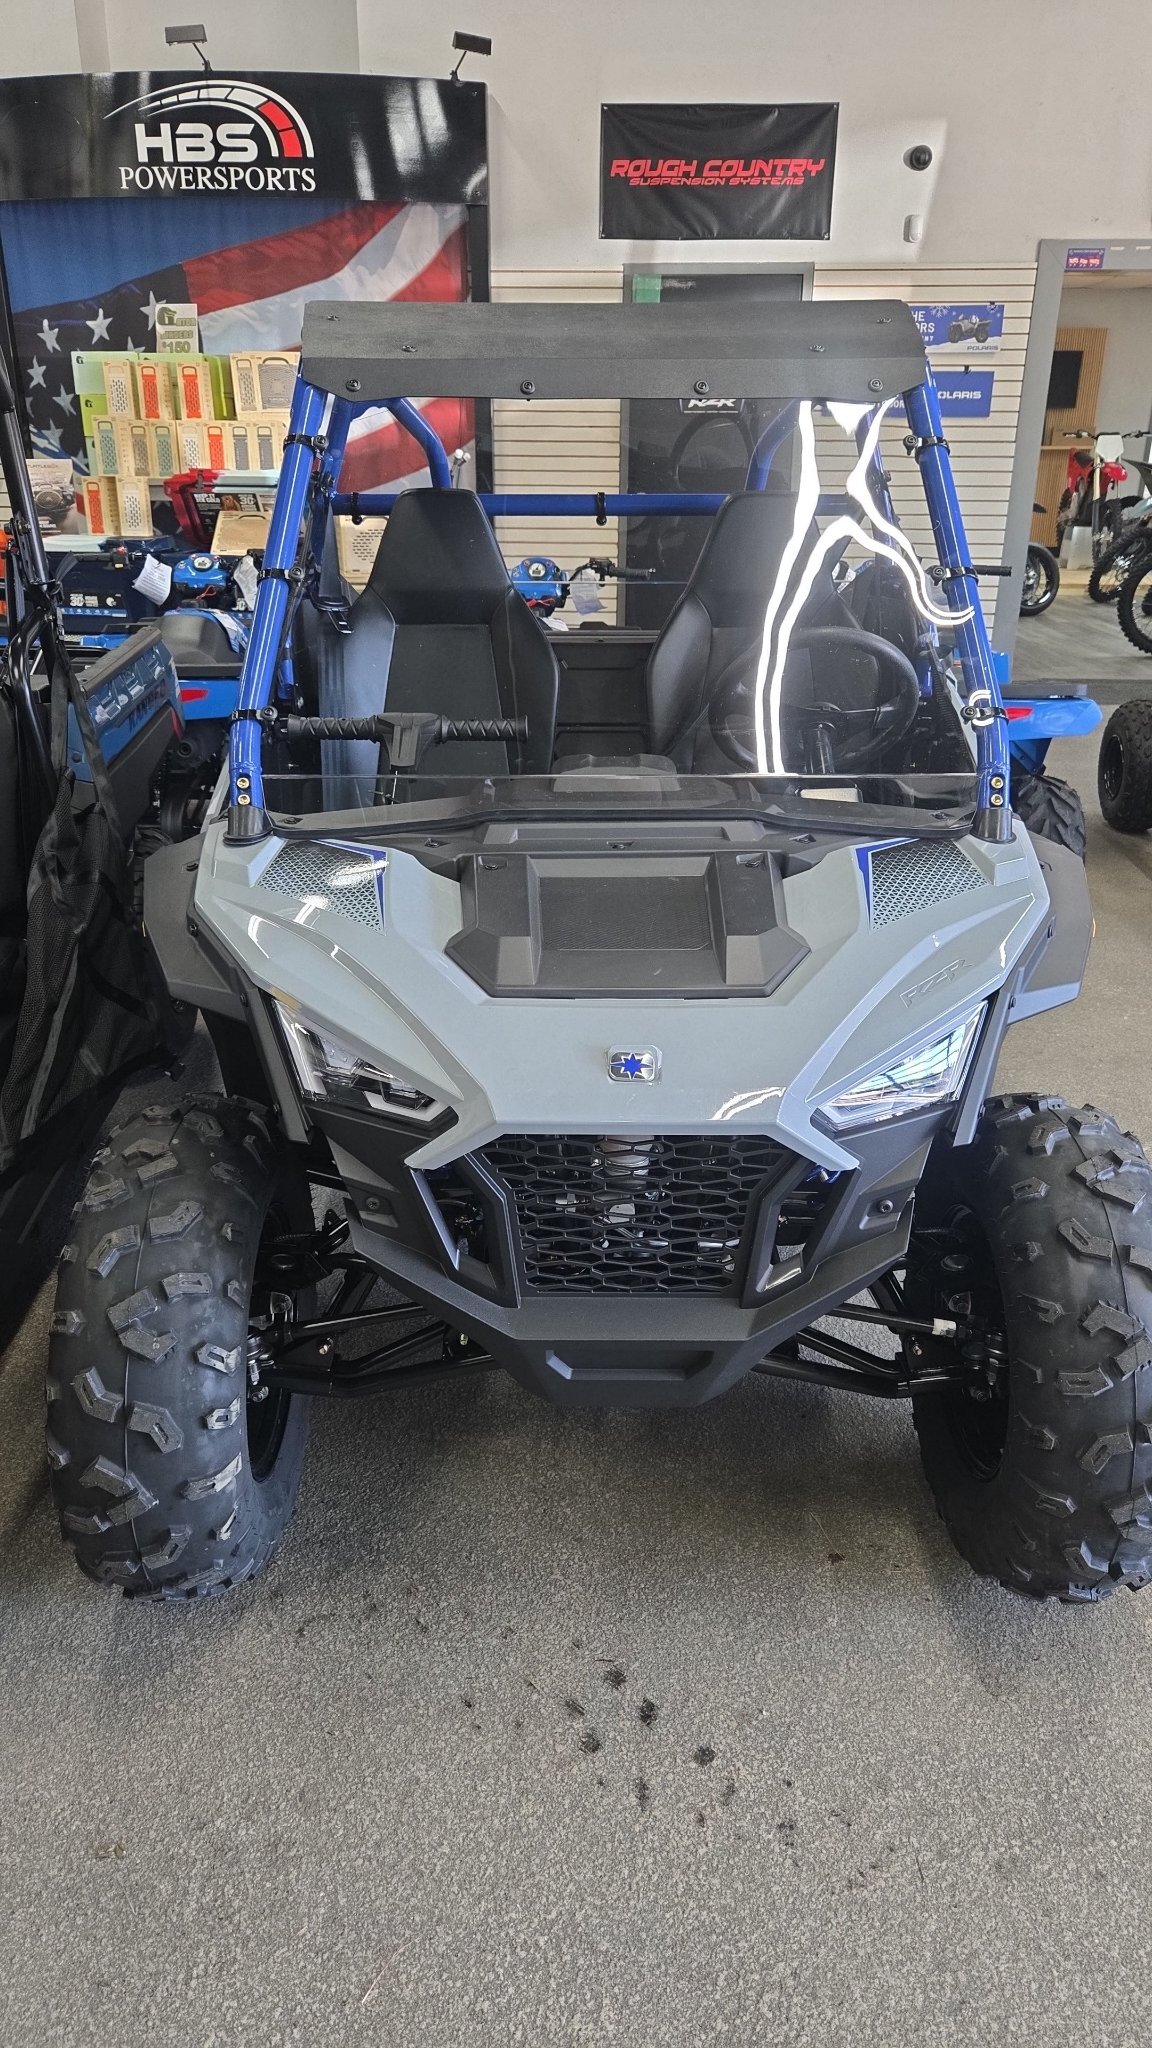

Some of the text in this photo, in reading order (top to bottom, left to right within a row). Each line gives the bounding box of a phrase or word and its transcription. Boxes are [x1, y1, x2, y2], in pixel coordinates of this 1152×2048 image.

[134, 122, 259, 163] HBS
[610, 158, 826, 177] ROUGH COUNTRY
[118, 166, 317, 192] POWERSPORTS
[629, 177, 805, 186] SUSPENSION SYSTEMS
[911, 310, 926, 321] HE
[937, 390, 982, 399] OLARIS
[899, 959, 973, 1008] RZR
